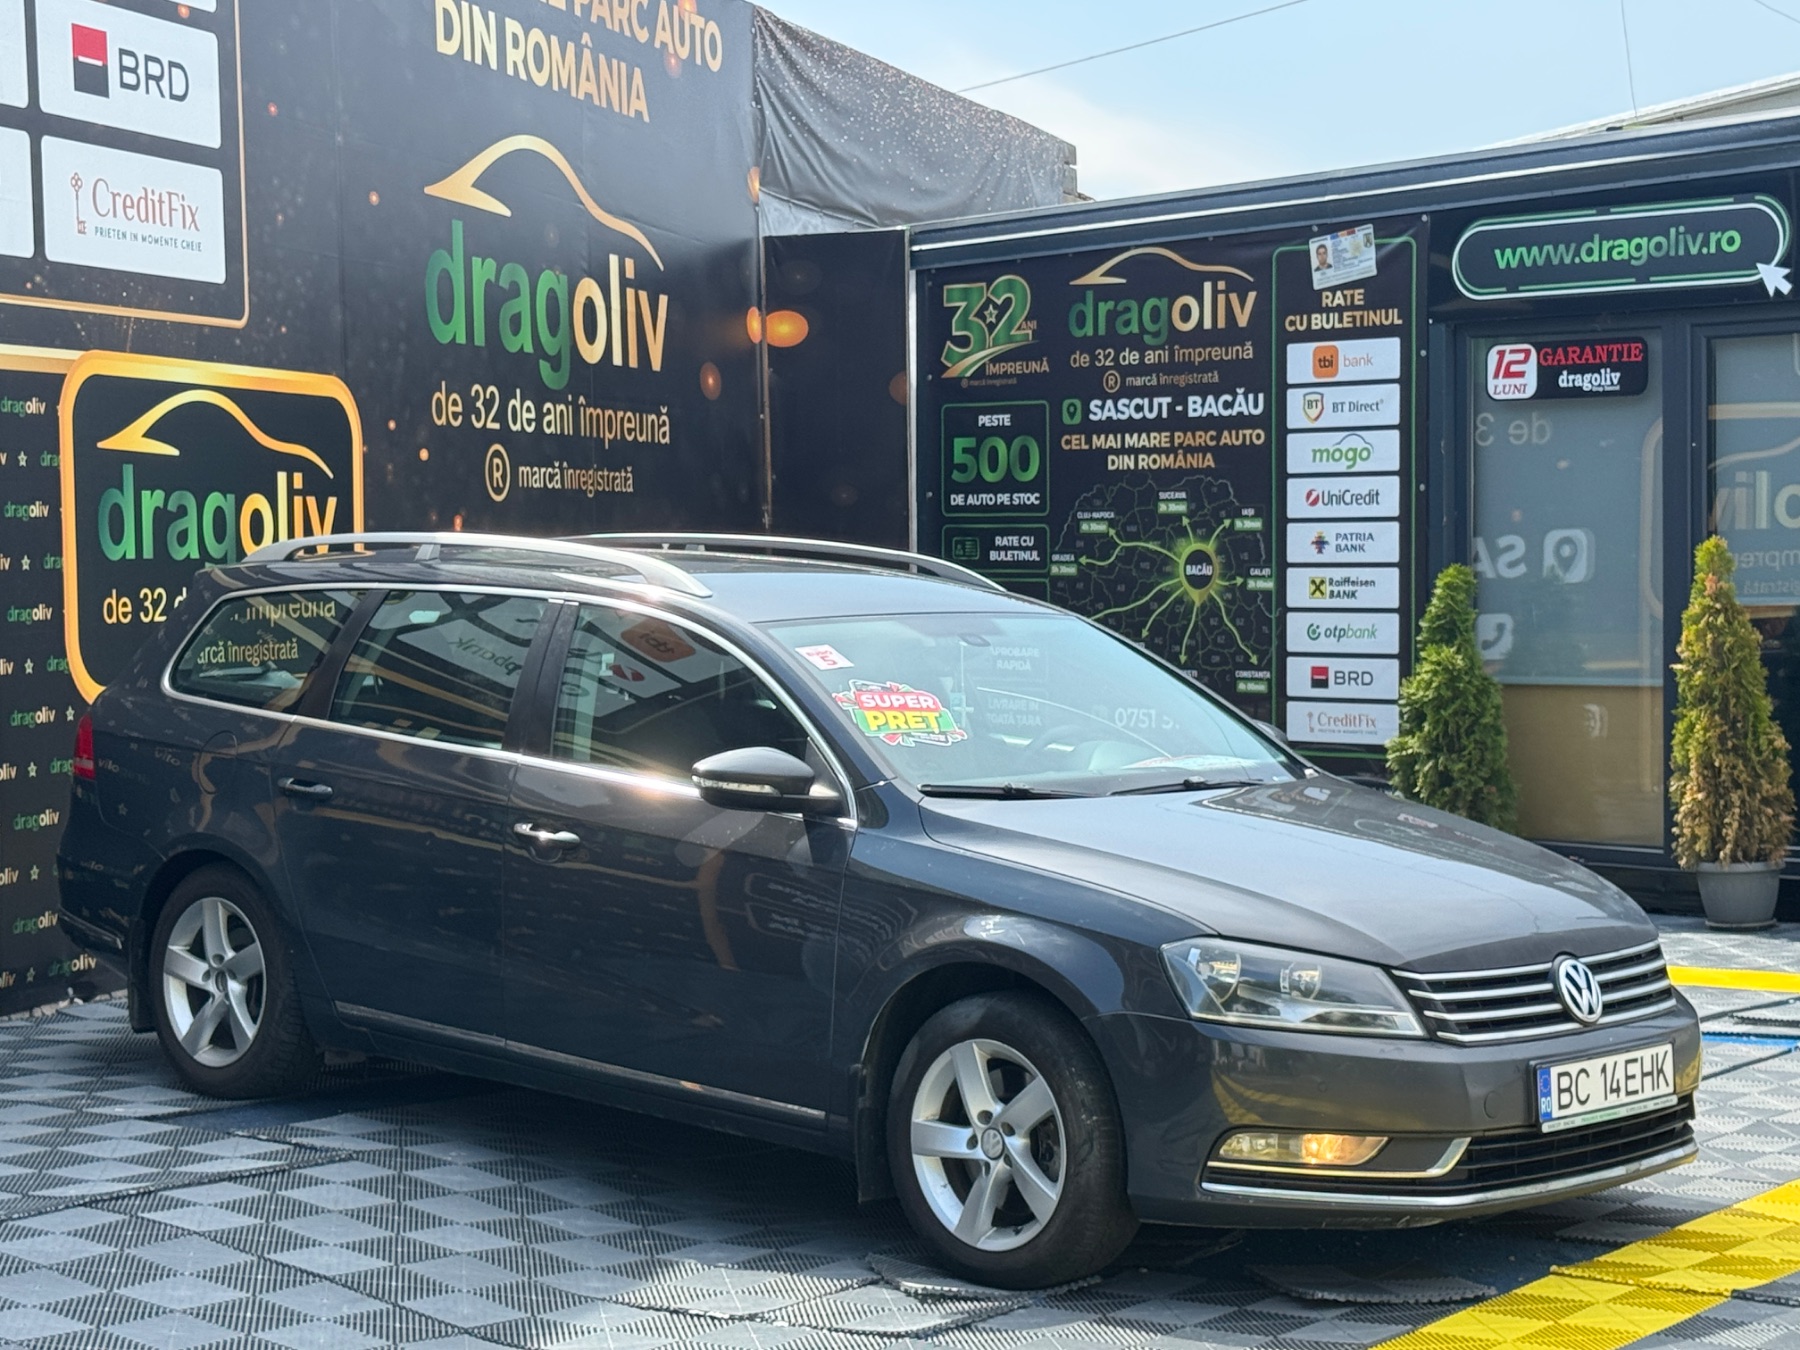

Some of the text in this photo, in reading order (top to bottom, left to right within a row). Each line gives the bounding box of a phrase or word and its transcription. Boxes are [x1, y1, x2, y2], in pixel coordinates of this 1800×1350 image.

[654, 0, 723, 73] AUTO
[434, 0, 650, 123] DIN ROMÂNIA
[118, 47, 190, 103] BRD
[92, 178, 201, 232] CreditFix
[94, 226, 202, 252] PRIETEN IN MOMENTE CHEIE
[1493, 225, 1742, 269] www.dragoliv.ro
[425, 219, 669, 391] dragoliv
[1321, 289, 1365, 308] RATE
[1068, 280, 1258, 346] dragoliv
[1284, 308, 1403, 332] CU BULETINUL
[1070, 341, 1254, 368] de 32 de ani împreună
[1317, 353, 1374, 369] tbi bank
[1491, 348, 1532, 380] 12
[1539, 343, 1644, 366] GARANTIE
[985, 357, 1050, 376] ÎMPREUNĂ
[1125, 373, 1158, 388] marcă
[1159, 371, 1219, 388] înregistrată
[1492, 383, 1527, 395] LUNI
[1558, 367, 1621, 391] dragoliv
[0, 397, 46, 417] dragoliv
[432, 380, 671, 450] de 32 de ani împreună
[1088, 397, 1172, 421] SASCUT
[1187, 388, 1265, 418] BACĂU
[1332, 402, 1346, 413] BT
[978, 414, 1011, 427] PESTE
[1061, 429, 1265, 450] CEL MAI MARE PARC AUTO
[951, 435, 1040, 483] 500
[1107, 450, 1215, 471] DIN ROMÂNIA
[1311, 445, 1372, 470] mogo
[518, 461, 562, 490] marcă
[563, 461, 634, 498] înregistrată
[950, 493, 1040, 505] DE AUTO PE STOC
[1321, 489, 1380, 506] UniCredit
[4, 501, 49, 521] dragoliv
[98, 463, 338, 569] dragoliv
[995, 536, 1034, 546] RATE CU
[1335, 532, 1375, 542] PATRIA
[989, 551, 1040, 561] BULETINUL
[1335, 544, 1366, 553] BANK
[1328, 577, 1376, 588] Raiffeisen
[102, 589, 133, 624] de
[139, 587, 168, 623] 32
[1328, 590, 1358, 600] BANK
[7, 603, 53, 625] dragoliv
[1324, 624, 1377, 643] otpbank
[1334, 670, 1374, 686] BRD
[860, 694, 936, 709] SUPER
[10, 706, 56, 729] dragoliv
[1317, 711, 1377, 729] CreditFix
[13, 808, 60, 832] dragoliv
[12, 910, 59, 934] dragoliv
[1557, 1050, 1670, 1111] BC 14EHK
[1541, 1097, 1552, 1113] RO
